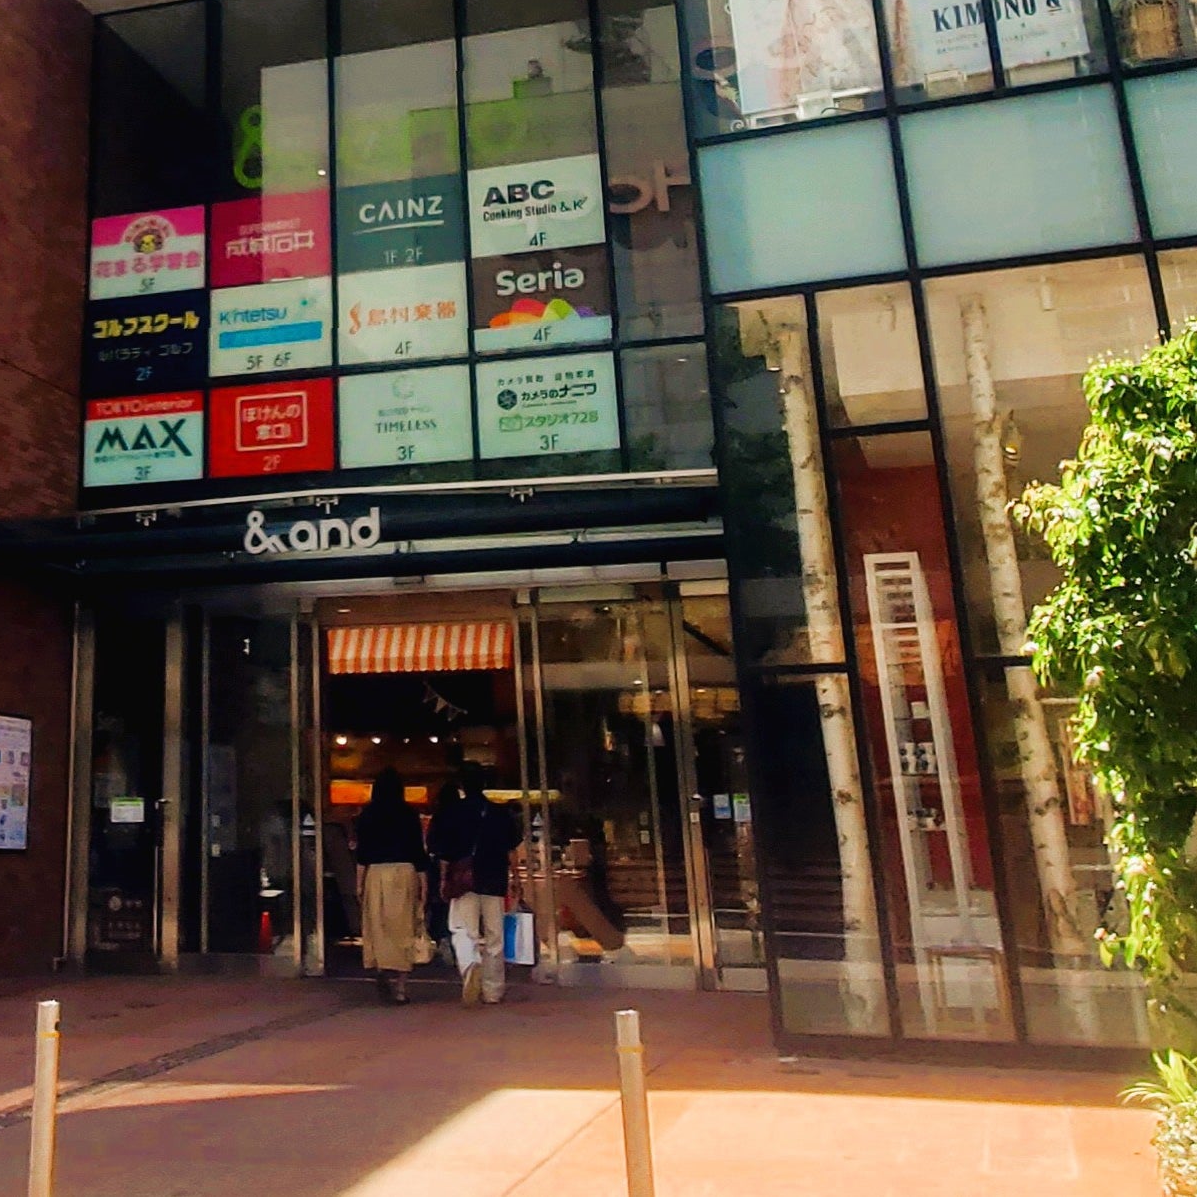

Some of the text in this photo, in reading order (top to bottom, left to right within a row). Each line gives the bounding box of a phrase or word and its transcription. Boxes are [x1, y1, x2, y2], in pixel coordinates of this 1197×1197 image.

[483, 180, 555, 207] ABC
[359, 195, 444, 223] CAINZ
[483, 208, 522, 222] Cooking
[525, 203, 556, 216] Studio
[529, 232, 547, 246] 4F
[383, 248, 423, 264] 1F 2F
[496, 262, 585, 296] Seria
[92, 311, 200, 339] ゴルフスクール
[533, 326, 552, 342] 4F
[394, 340, 412, 355] 4F
[247, 352, 292, 370] 5F 6F
[242, 404, 301, 422] ほけんの
[95, 418, 192, 457] MAX
[540, 434, 559, 450] 3F
[397, 444, 415, 461] 3F
[263, 454, 281, 471] 2F
[134, 466, 151, 481] 3F
